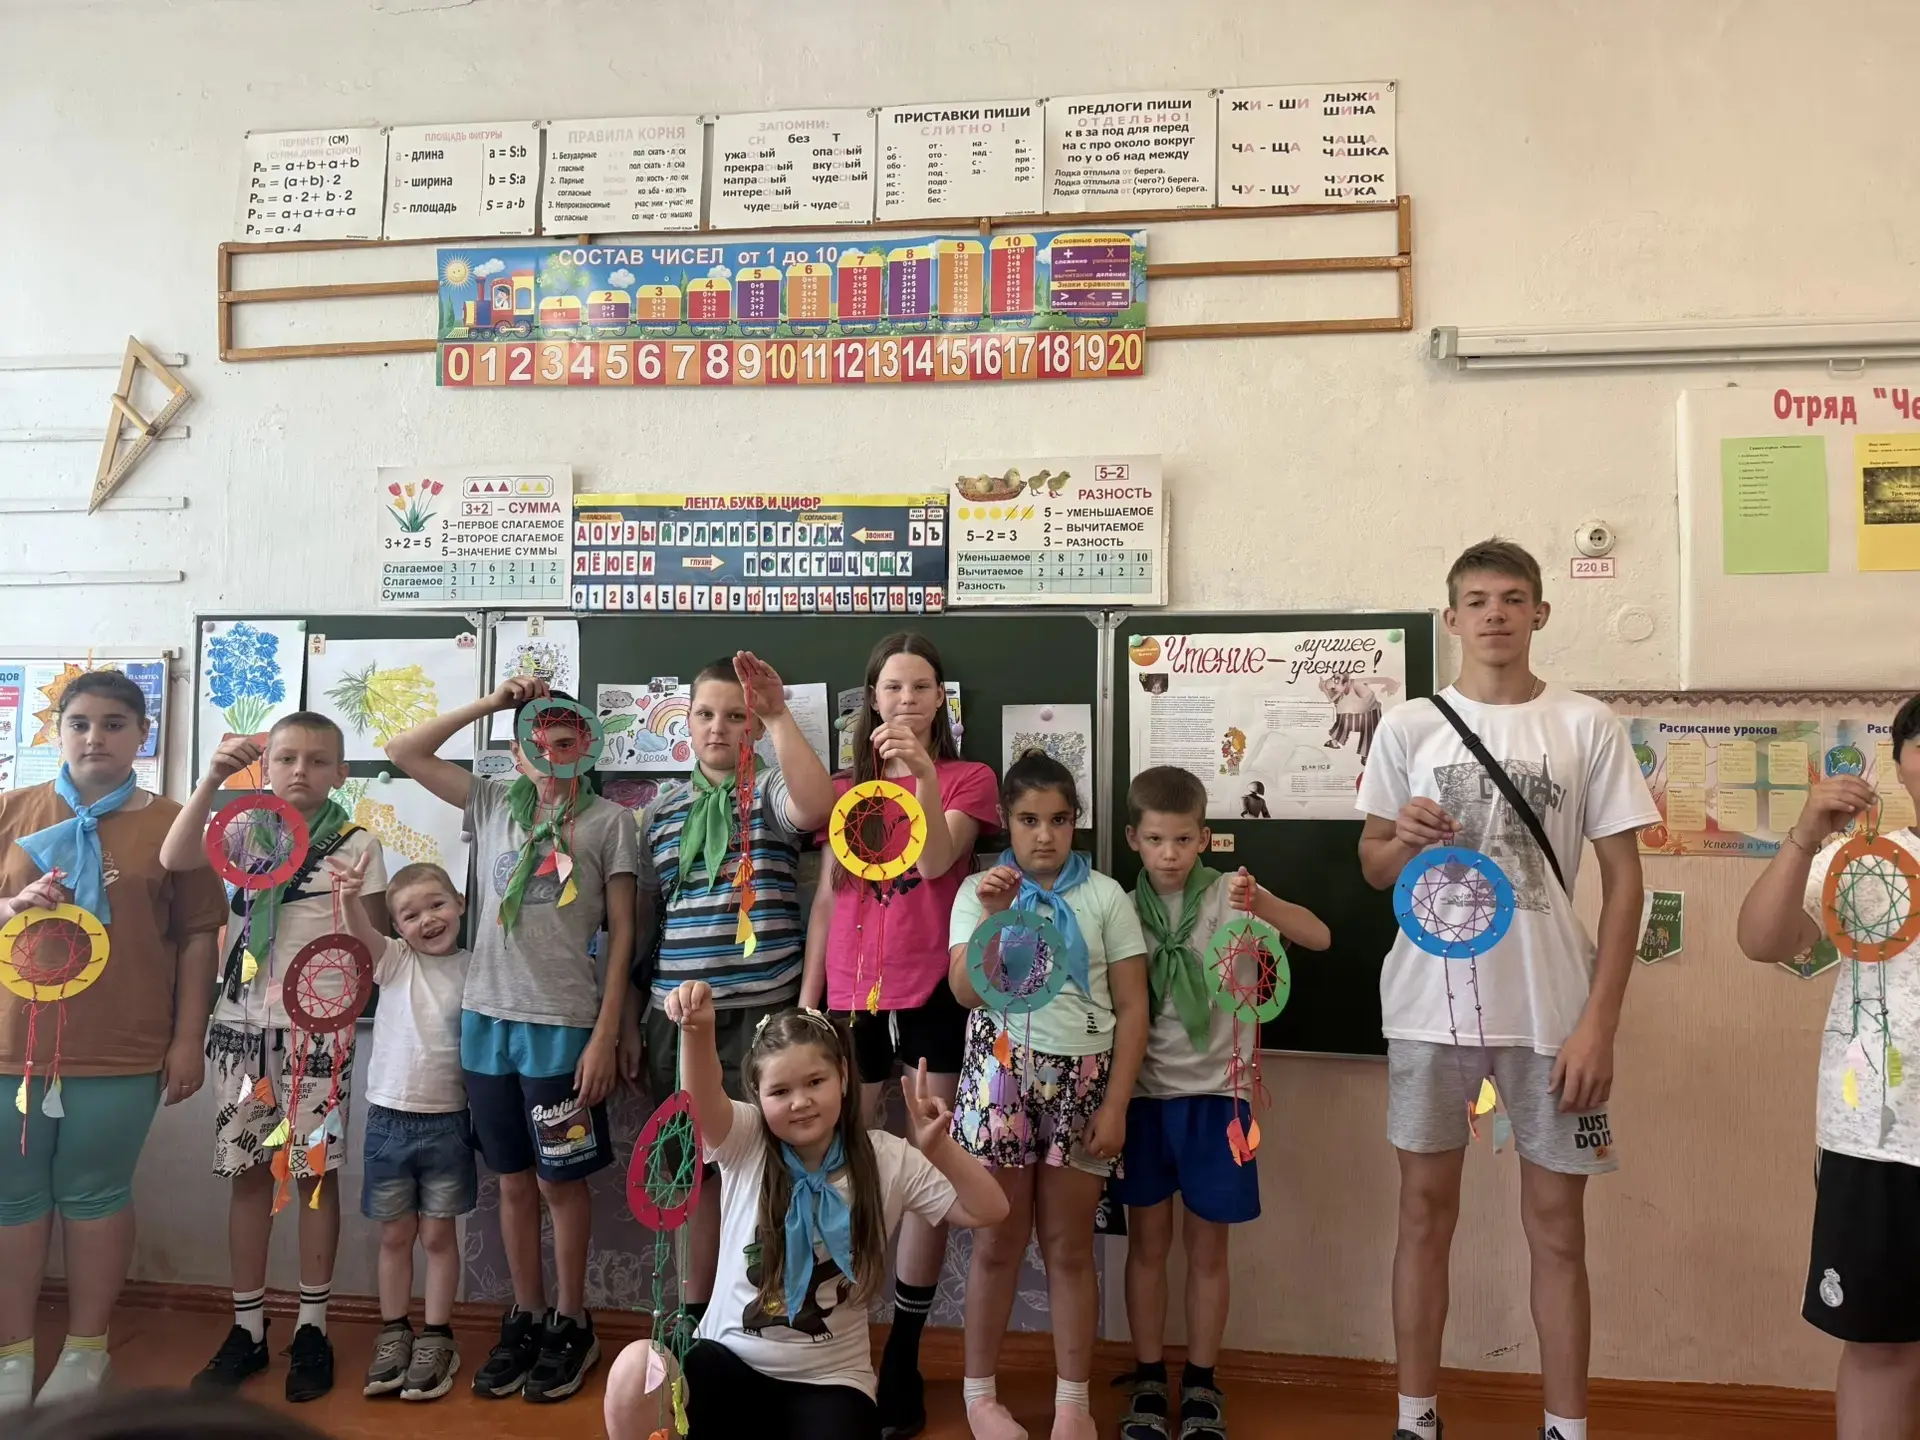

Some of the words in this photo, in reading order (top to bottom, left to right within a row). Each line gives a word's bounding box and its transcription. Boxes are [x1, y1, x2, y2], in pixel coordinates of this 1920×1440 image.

[1323, 92, 1380, 102] ЛЫЖИ
[1068, 103, 1142, 115] ПРЕДЛОГИ
[1147, 100, 1191, 110] ПИШИ
[1232, 100, 1261, 111] ЖИ
[1280, 98, 1309, 109] ШИ
[894, 110, 979, 123] ПРИСТАВКИ
[985, 107, 1030, 118] ПИШИ
[1324, 106, 1375, 116] ШИНА
[569, 130, 633, 144] ПРАВИЛА
[638, 127, 685, 140] КОРНЯ
[1102, 127, 1124, 136] под
[1127, 126, 1149, 135] для
[1153, 124, 1189, 134] перед
[328, 135, 349, 146] (СМ)
[425, 132, 466, 142] ПЛОЩАДЬ
[469, 131, 502, 139] ФИГУРЫ
[788, 134, 810, 143] без
[832, 133, 840, 142] Т
[1323, 135, 1378, 145] ЧАЩА
[1063, 142, 1076, 150] на
[1090, 141, 1111, 150] про
[1115, 138, 1150, 148] около
[1154, 136, 1195, 146] вокруг
[1232, 143, 1255, 152] ЧА
[1272, 143, 1301, 154] ЩА
[412, 150, 444, 162] длина
[813, 146, 862, 157] опасный
[1106, 153, 1120, 161] об
[1124, 153, 1145, 161] над
[1150, 150, 1189, 160] между
[1323, 147, 1389, 157] ЧАШКА
[724, 162, 793, 173] прекрасный
[813, 159, 861, 171] вкусный
[1055, 169, 1081, 177] Лодка
[1134, 167, 1165, 176] берега.
[412, 177, 452, 189] ширина
[724, 175, 786, 186] напрасный
[813, 172, 867, 183] чудесный
[1054, 179, 1081, 187] Лодка
[1134, 177, 1165, 185] (чего?)
[1168, 176, 1199, 184] берега.
[1325, 174, 1385, 184] ЧУЛОК
[723, 187, 791, 198] интересный
[1133, 187, 1173, 195] (крутого)
[1176, 186, 1207, 194] берега.
[1232, 185, 1255, 195] ЧУ
[1272, 185, 1300, 195] ЩУ
[1325, 187, 1376, 197] ЩУКА
[410, 203, 457, 213] площадь
[957, 242, 965, 252] 9
[1005, 237, 1021, 246] 10
[559, 249, 644, 265] СОСТАВ
[652, 248, 723, 265] ЧИСЕЛ
[739, 252, 760, 264] от
[767, 248, 775, 263] 1
[782, 251, 809, 266] до
[816, 247, 838, 263] 10
[906, 249, 913, 258] 8
[856, 256, 864, 265] 7
[754, 270, 762, 278] 5
[448, 346, 470, 381] 0
[481, 346, 496, 382] 1
[510, 346, 531, 380] 2
[542, 346, 564, 379] 3
[571, 344, 594, 379] 4
[606, 344, 628, 379] 5
[638, 344, 661, 379] 6
[671, 344, 695, 379] 7
[707, 343, 729, 380] 8
[738, 343, 761, 379] 9
[766, 343, 796, 378] 10
[802, 343, 827, 378] 11
[833, 342, 863, 378] 12
[867, 341, 899, 377] 13
[902, 339, 934, 376] 14
[937, 338, 967, 375] 15
[971, 337, 1001, 374] 16
[1004, 336, 1035, 373] 17
[1039, 335, 1070, 372] 18
[1073, 334, 1105, 371] 19
[1107, 333, 1141, 371] 20
[1774, 389, 1857, 426] Отряд
[1078, 488, 1152, 499] РАЗНОСТЬ
[685, 497, 726, 508] ЛЕНТА
[730, 496, 764, 508] БУКВ
[768, 497, 778, 507] И
[782, 497, 821, 508] ЦИФР
[509, 502, 561, 514] СУММА
[1067, 507, 1153, 517] УМЕНЬШАЕМОЕ
[501, 521, 564, 529] СЛАГАЕМОЕ
[1067, 523, 1144, 532] ВЫЧИТАЕМОЕ
[501, 534, 564, 543] СЛАГАЕМОЕ
[1067, 538, 1123, 546] РАЗНОСТЬ
[515, 547, 557, 556] СУММЫ
[958, 554, 1030, 562] Уменьшаемое
[384, 564, 443, 575] Слагаемое
[958, 568, 1023, 577] Вычитаемое
[1577, 562, 1597, 574] 220
[383, 577, 443, 587] Слагаемое
[958, 582, 1005, 590] Разность
[383, 590, 419, 601] Сумма
[1295, 637, 1375, 660] лучшее
[1659, 723, 1730, 735] Расписание
[1734, 725, 1778, 736] уроков
[1703, 839, 1745, 850] Успехов
[532, 1098, 580, 1121] Surfin
[1578, 1114, 1607, 1132] JUST
[1574, 1132, 1601, 1149] DO
